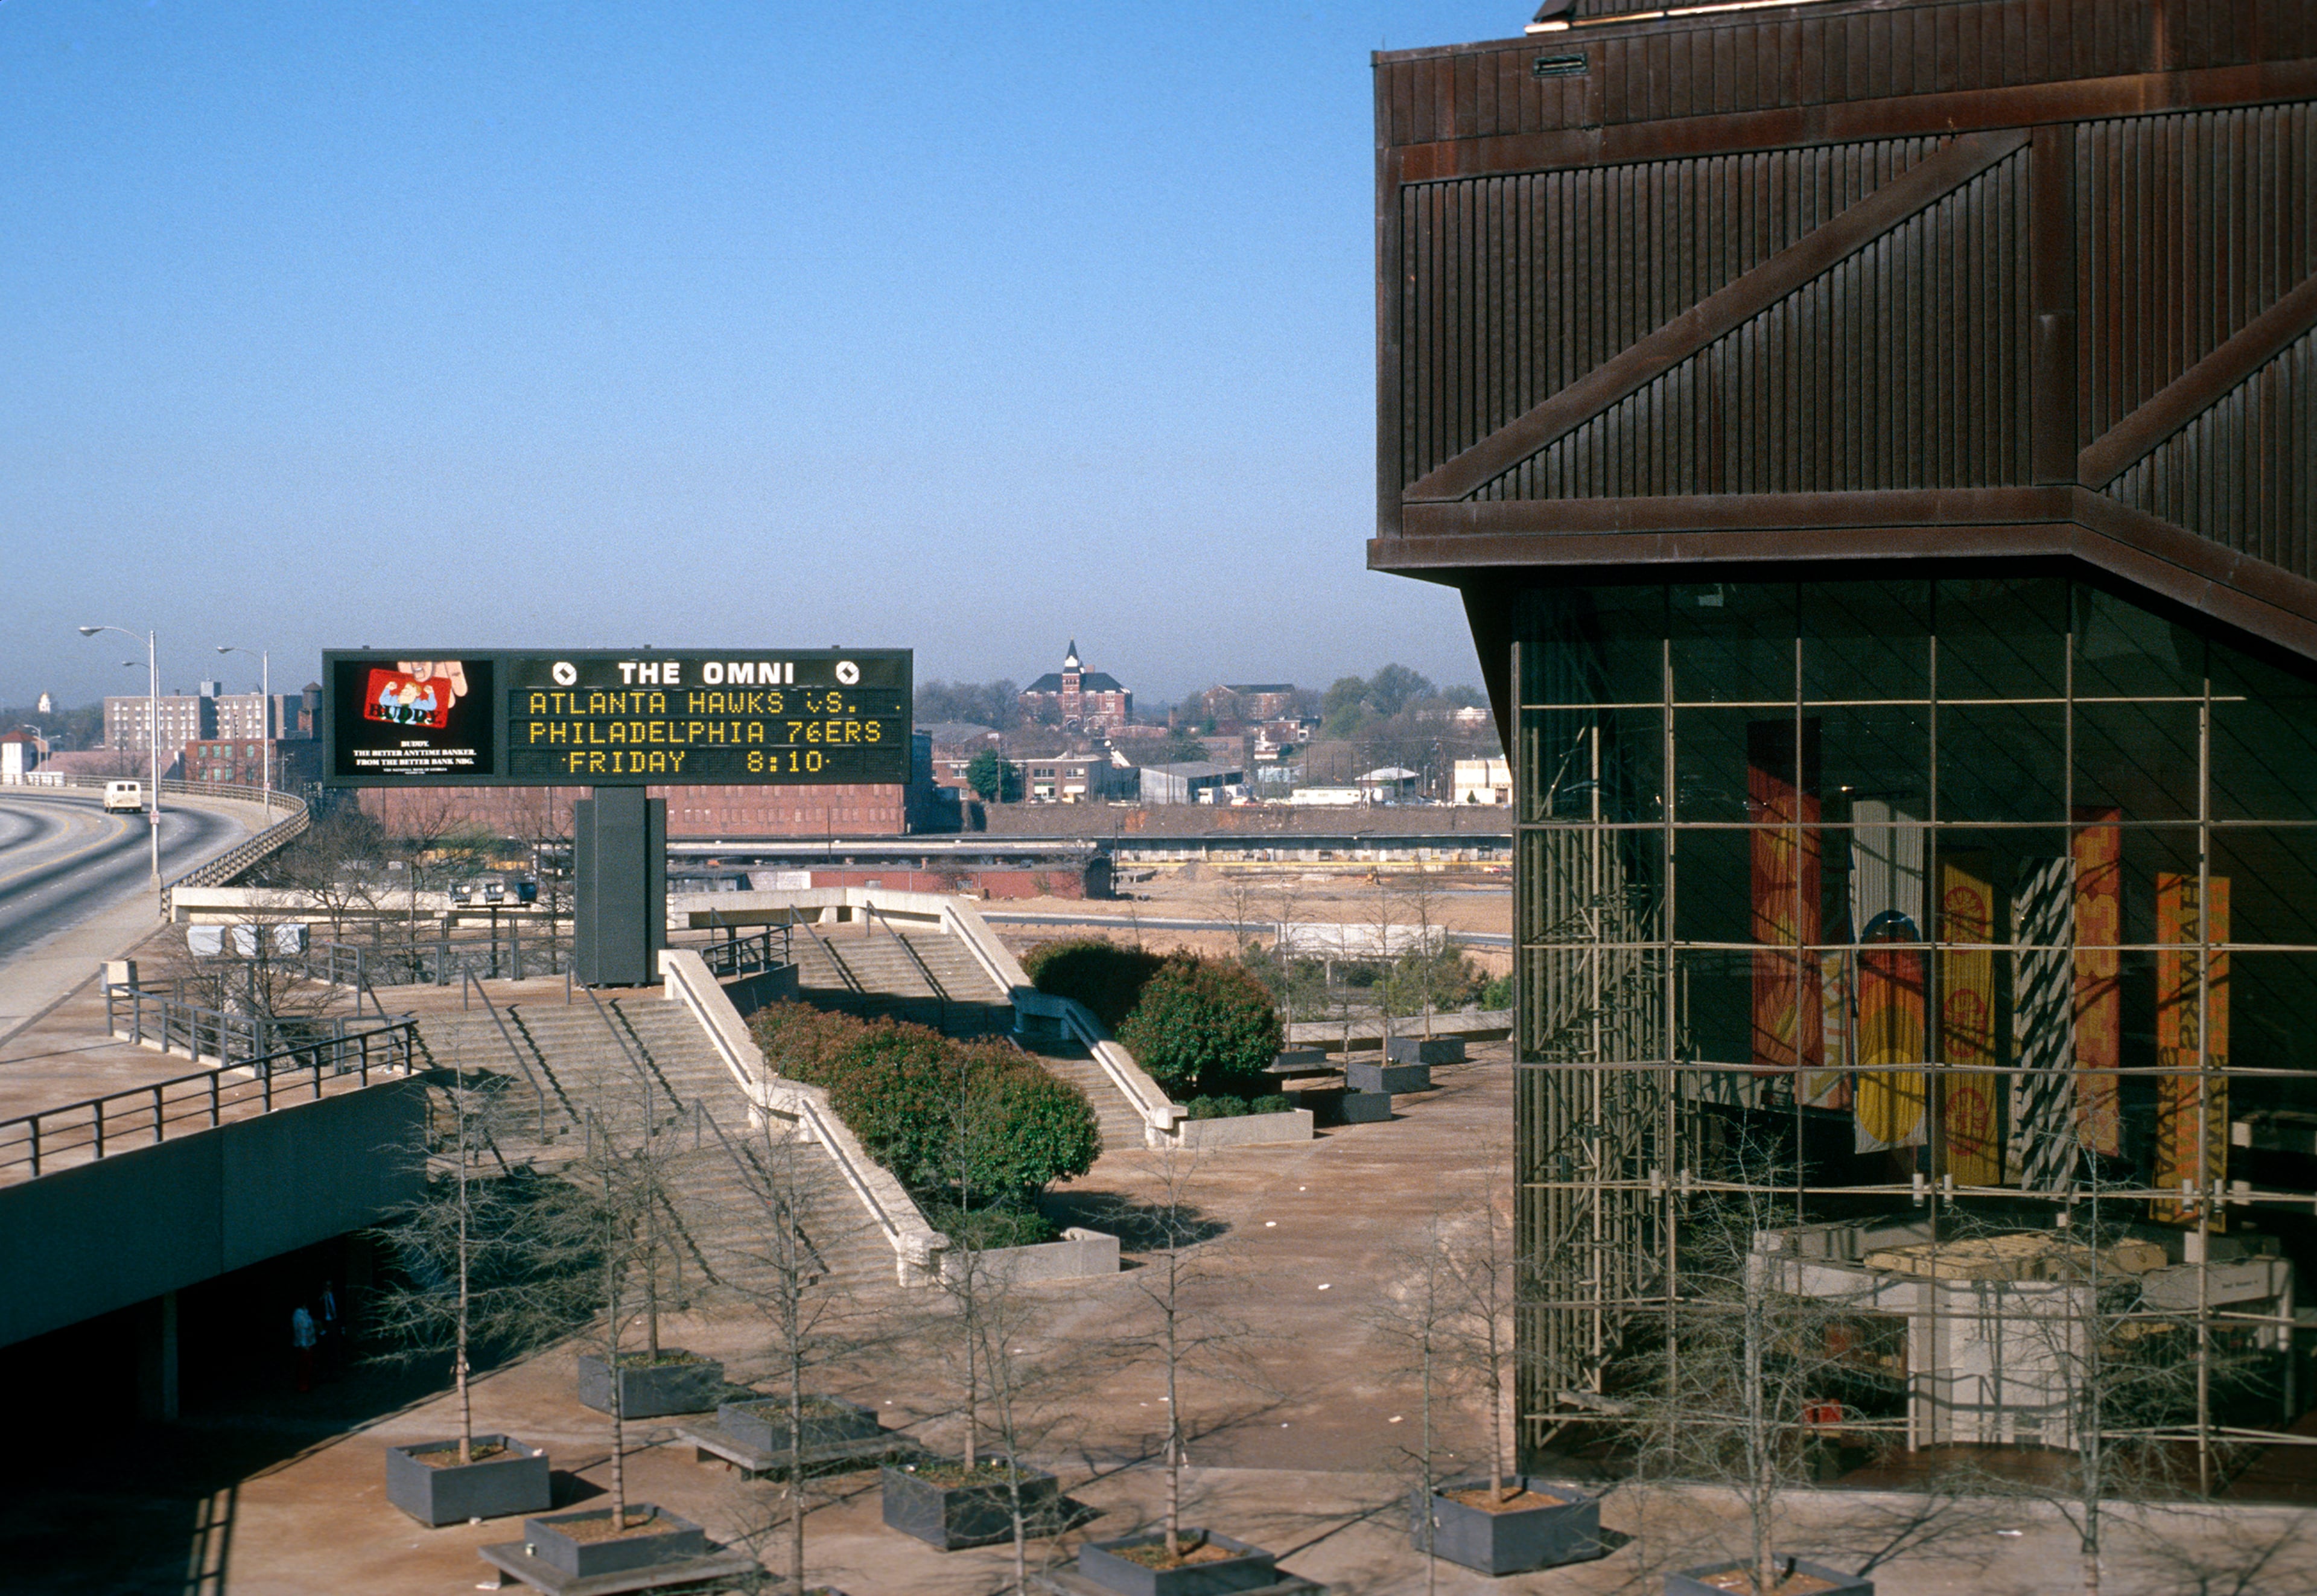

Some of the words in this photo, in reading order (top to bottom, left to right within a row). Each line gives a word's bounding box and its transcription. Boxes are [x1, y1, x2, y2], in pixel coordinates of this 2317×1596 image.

[618, 663, 680, 684] THE
[703, 662, 793, 684] OMNI
[530, 692, 665, 714] ATLANTA
[688, 692, 783, 714] HAWKS
[530, 721, 764, 743] PHILADELPHIA
[787, 720, 881, 743] 76ERS
[570, 751, 685, 773] FRIDAY
[746, 751, 821, 772] 8:10
